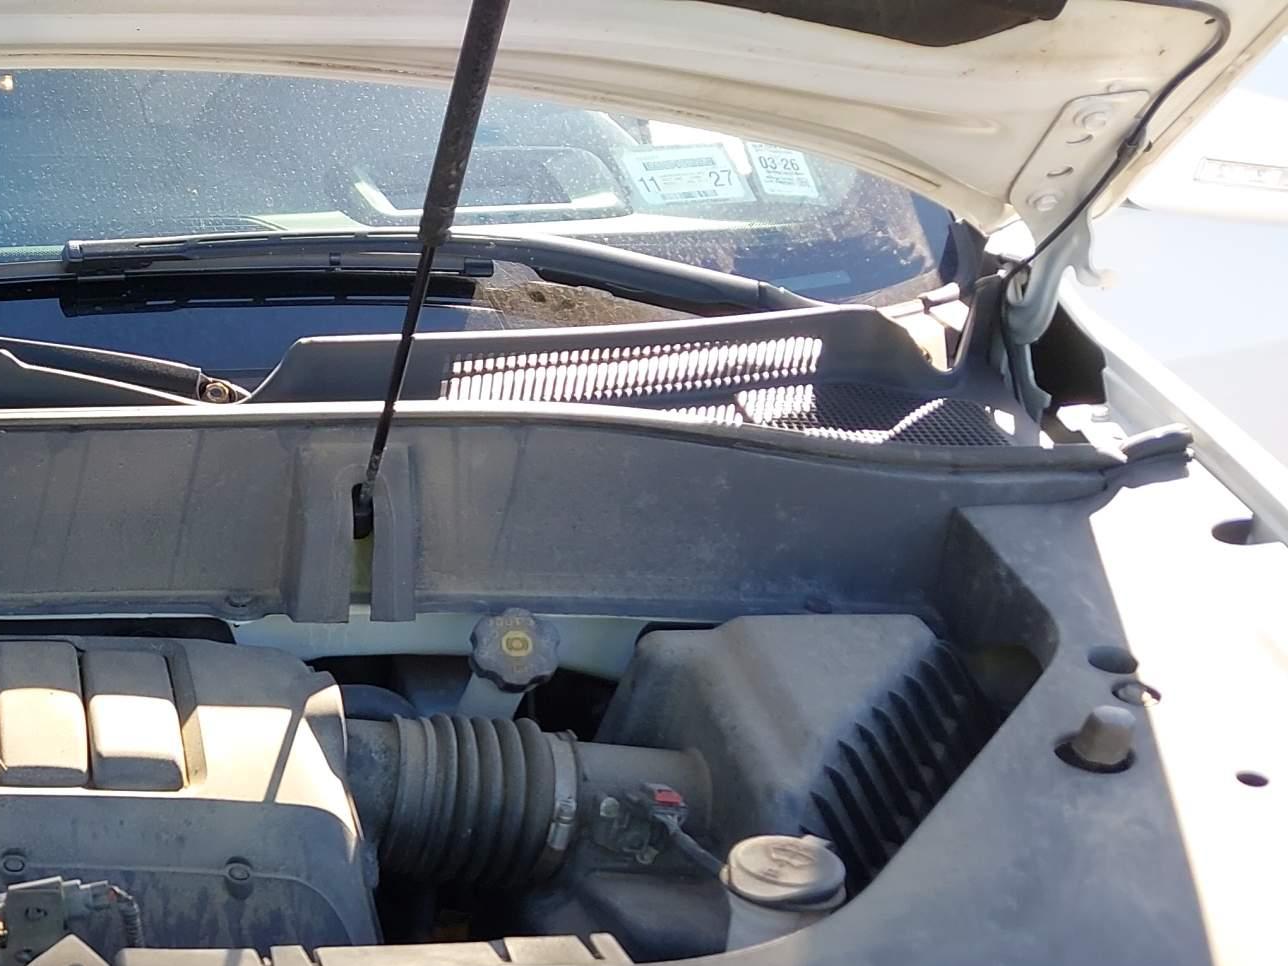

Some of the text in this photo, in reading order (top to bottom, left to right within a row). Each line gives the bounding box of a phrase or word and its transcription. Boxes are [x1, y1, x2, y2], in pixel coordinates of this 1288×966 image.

[758, 155, 800, 171] 03 26
[638, 176, 662, 193] 11
[708, 169, 733, 187] 27
